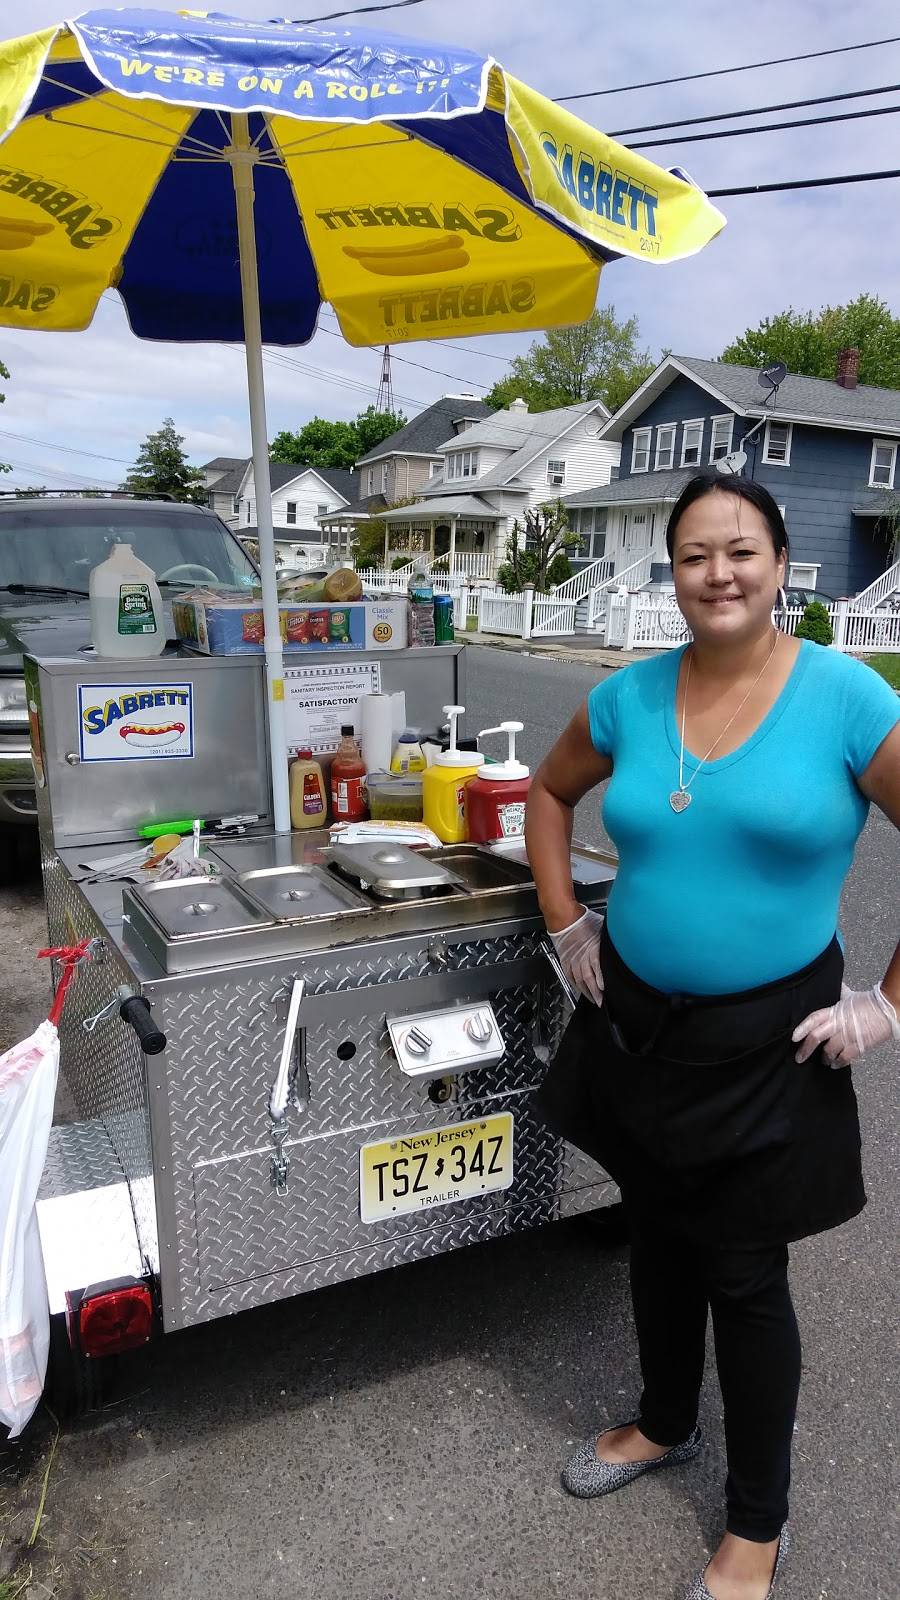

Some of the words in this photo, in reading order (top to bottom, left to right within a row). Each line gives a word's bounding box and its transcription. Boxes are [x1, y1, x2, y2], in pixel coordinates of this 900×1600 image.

[119, 59, 225, 88] WE'RE
[237, 75, 282, 95] ON
[293, 80, 315, 99] A
[326, 81, 402, 102] ROLL
[640, 236, 661, 255] 2017
[377, 626, 389, 636] 50
[83, 690, 188, 734] SABRETT
[298, 697, 359, 708] SATISFACTORY
[399, 1137, 434, 1152] New
[434, 1126, 477, 1147] Jersey
[372, 1152, 430, 1202] TSZ
[450, 1136, 504, 1183] 34Z
[419, 1189, 461, 1207] TRAILER
